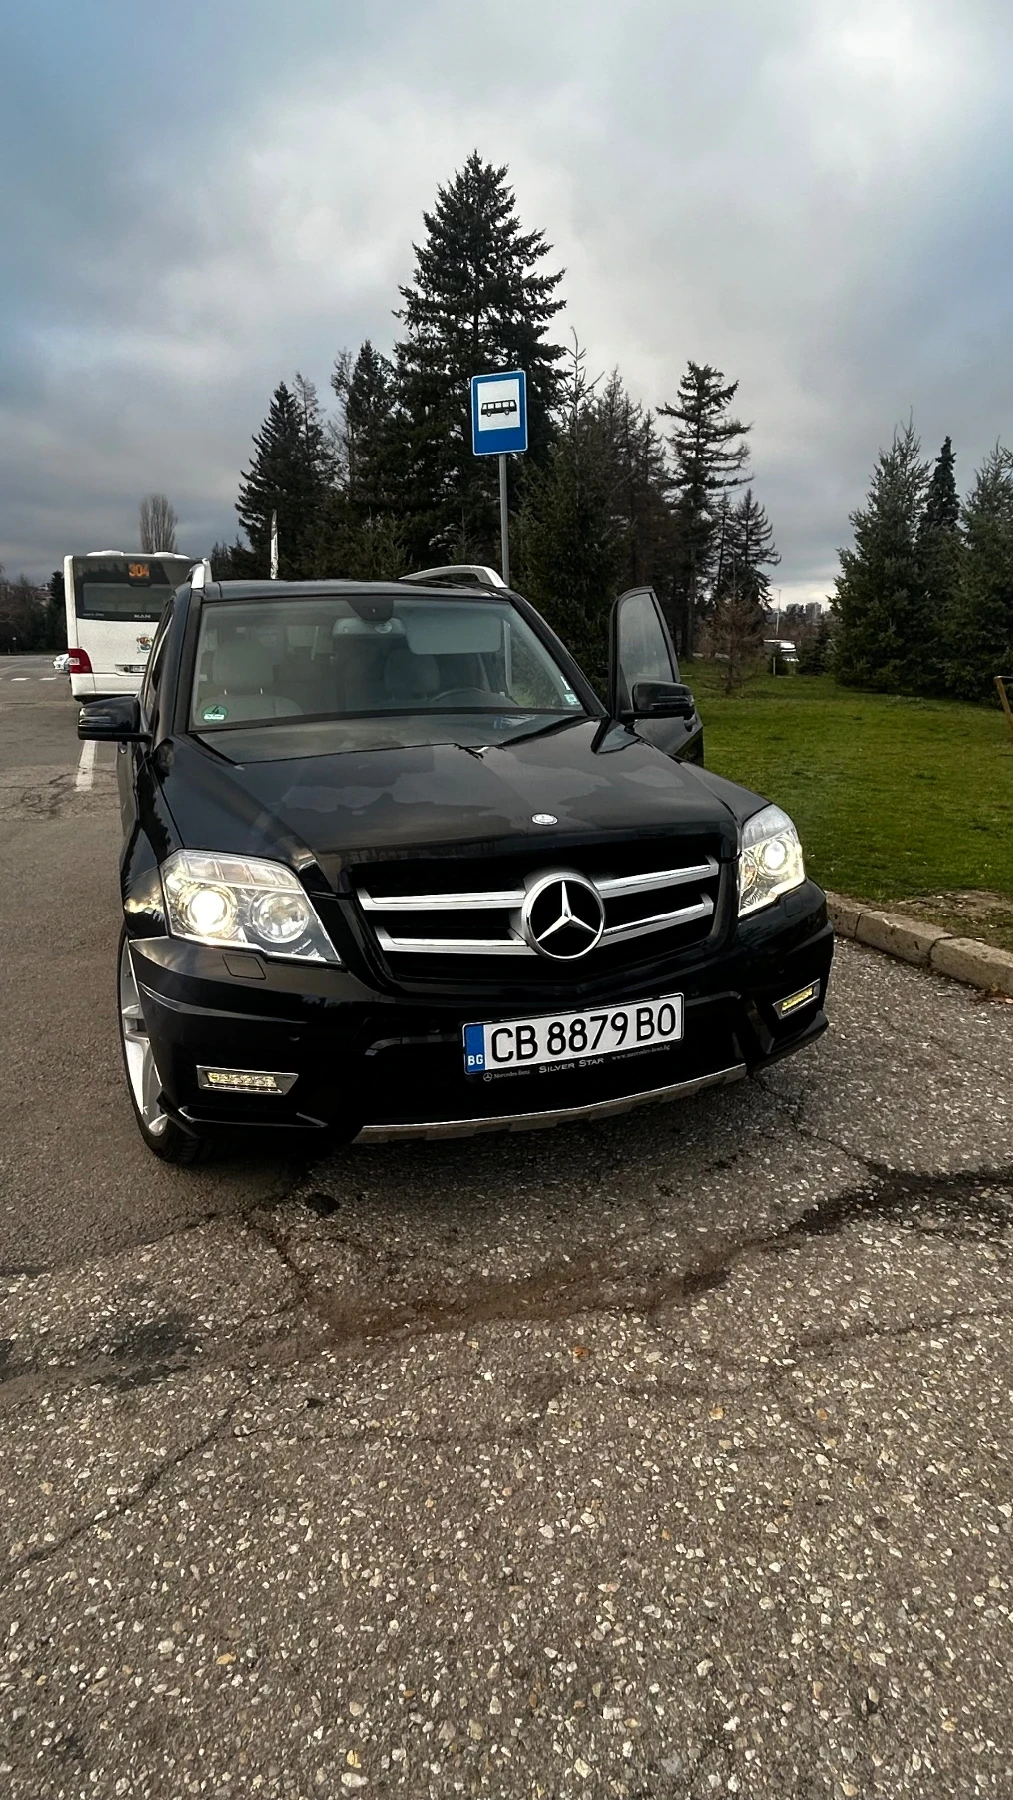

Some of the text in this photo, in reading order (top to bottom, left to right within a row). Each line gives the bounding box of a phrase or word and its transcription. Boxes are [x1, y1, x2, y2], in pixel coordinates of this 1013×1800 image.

[128, 563, 150, 577] 304
[491, 1003, 676, 1063] CB 8879 BO
[467, 1053, 484, 1067] BG
